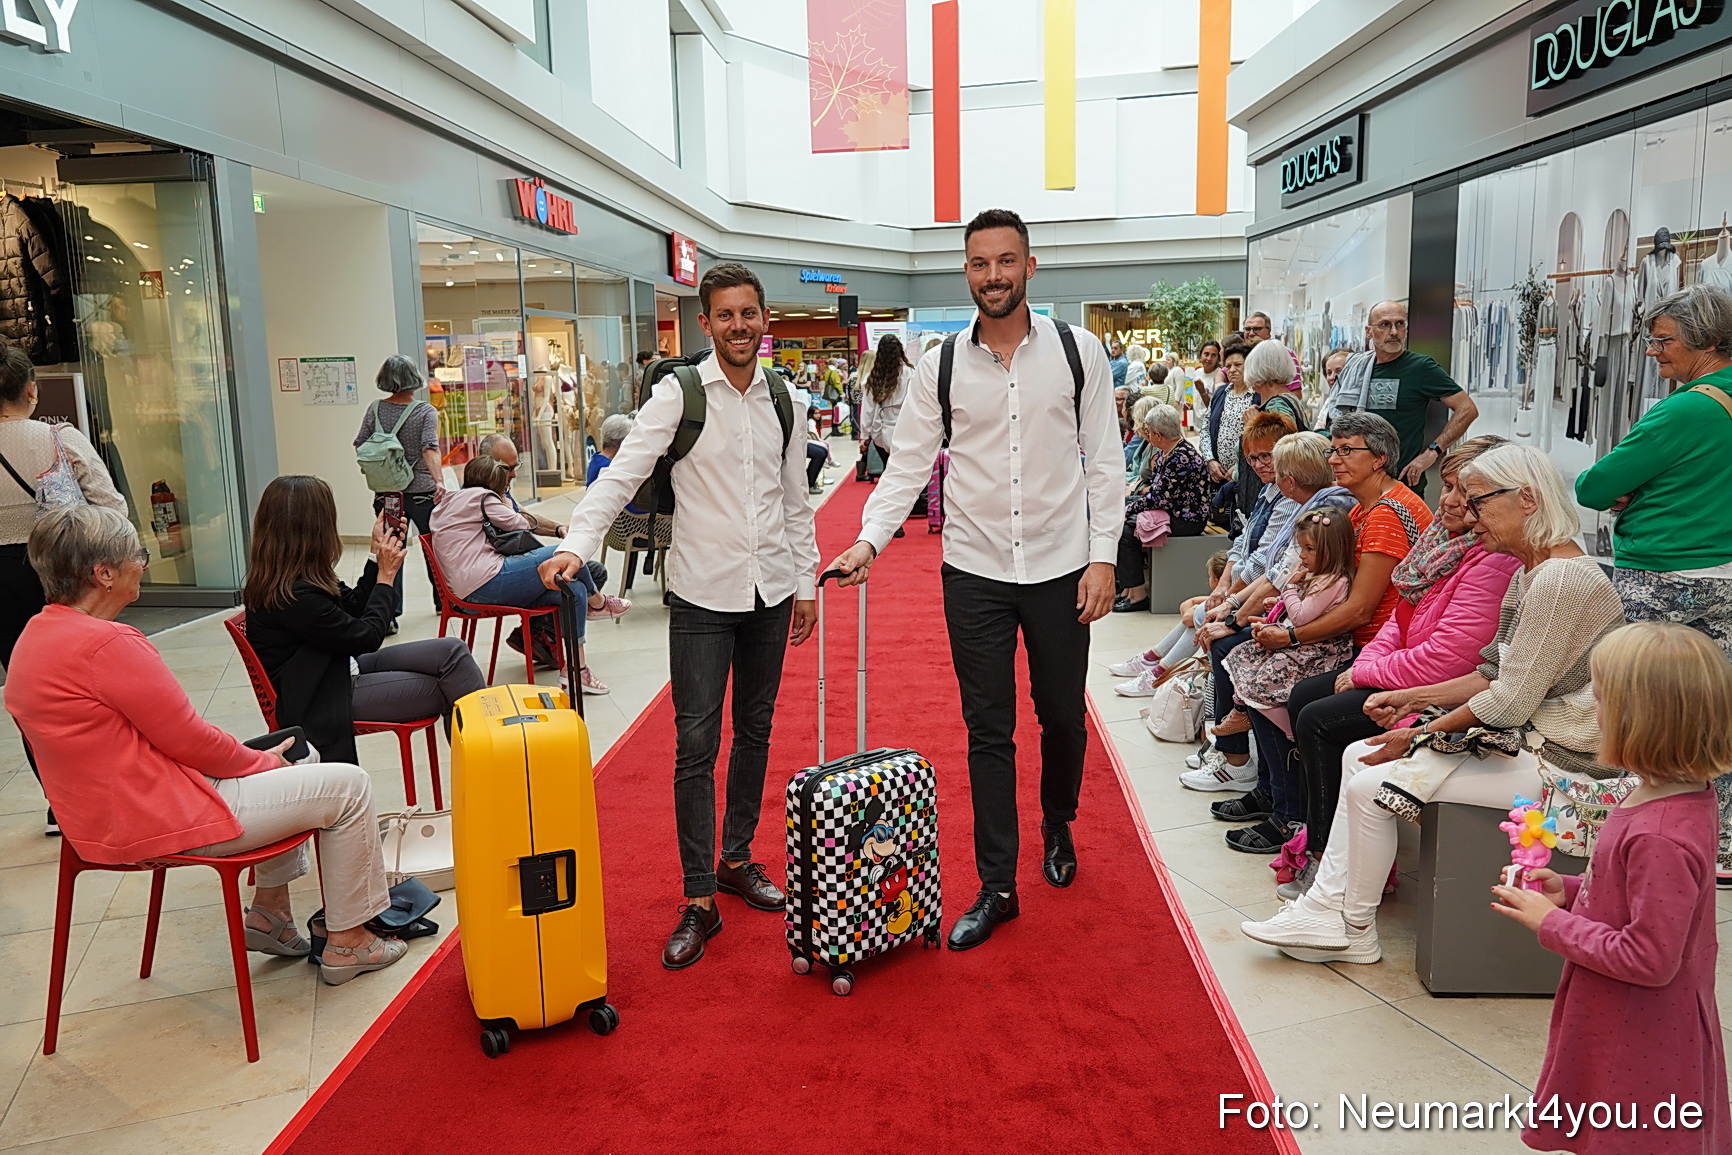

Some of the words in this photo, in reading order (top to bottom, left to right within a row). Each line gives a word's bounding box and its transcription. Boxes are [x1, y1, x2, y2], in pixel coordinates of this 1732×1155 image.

[1280, 135, 1341, 194] DOUGLAS
[515, 176, 578, 235] WÖHRL
[800, 268, 842, 283] Spielwaren
[826, 283, 848, 293] Krömer
[1116, 328, 1169, 345] VER
[38, 415, 69, 424] ONLY
